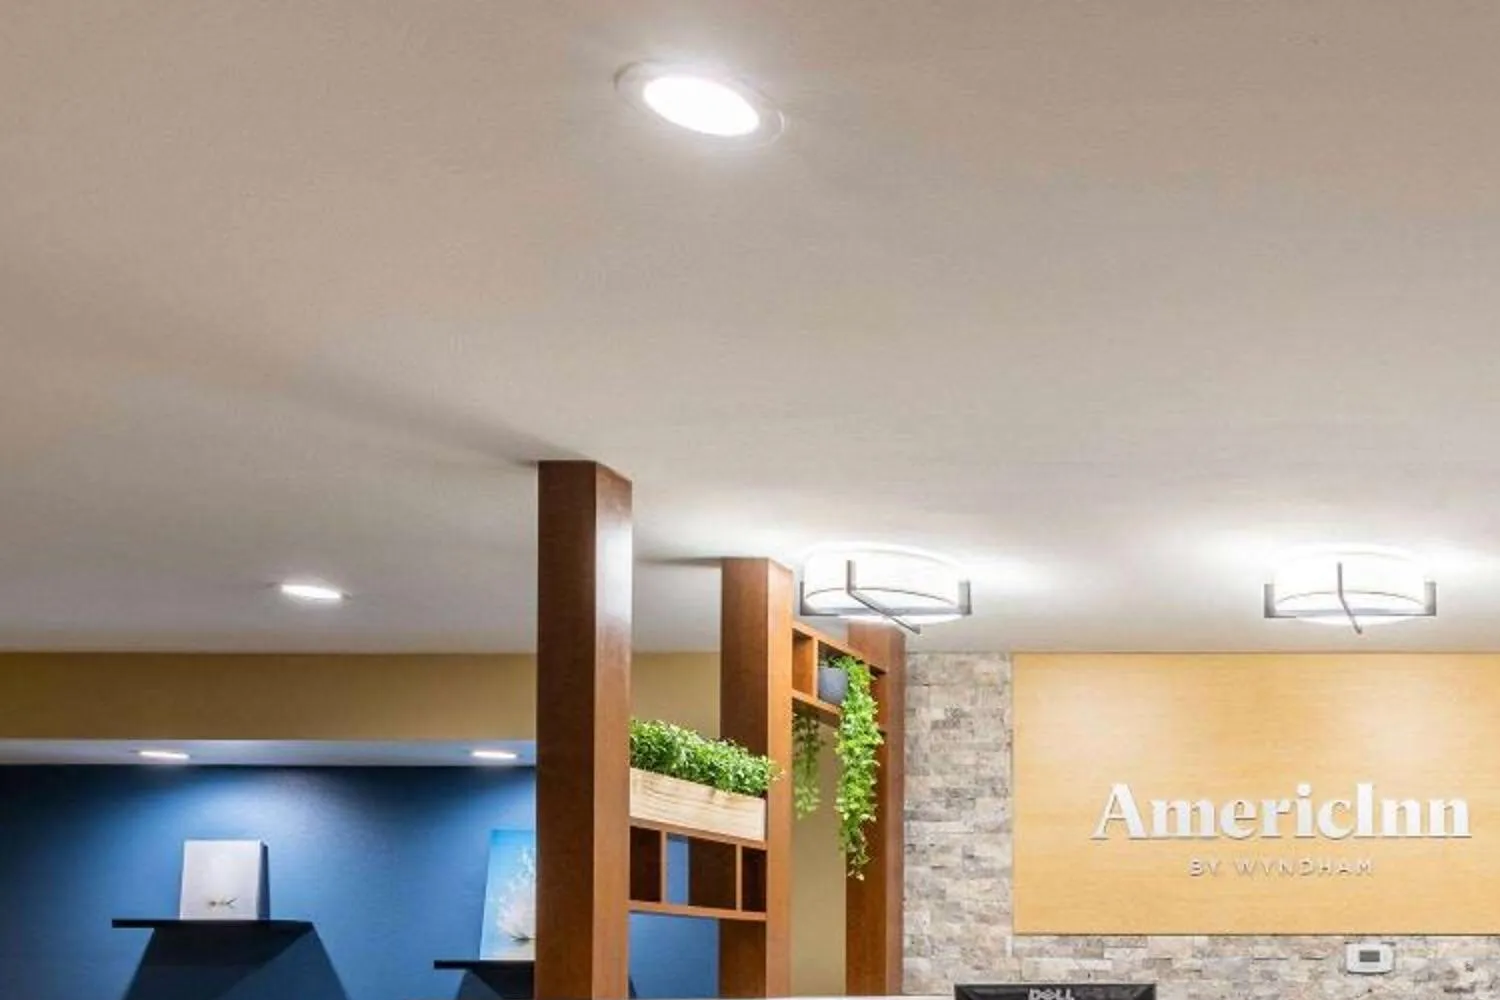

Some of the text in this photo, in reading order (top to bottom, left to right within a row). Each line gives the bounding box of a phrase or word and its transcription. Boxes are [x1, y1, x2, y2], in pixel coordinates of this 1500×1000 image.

[1090, 782, 1473, 840] AmericInn
[1189, 857, 1375, 877] BY WYNDHAM
